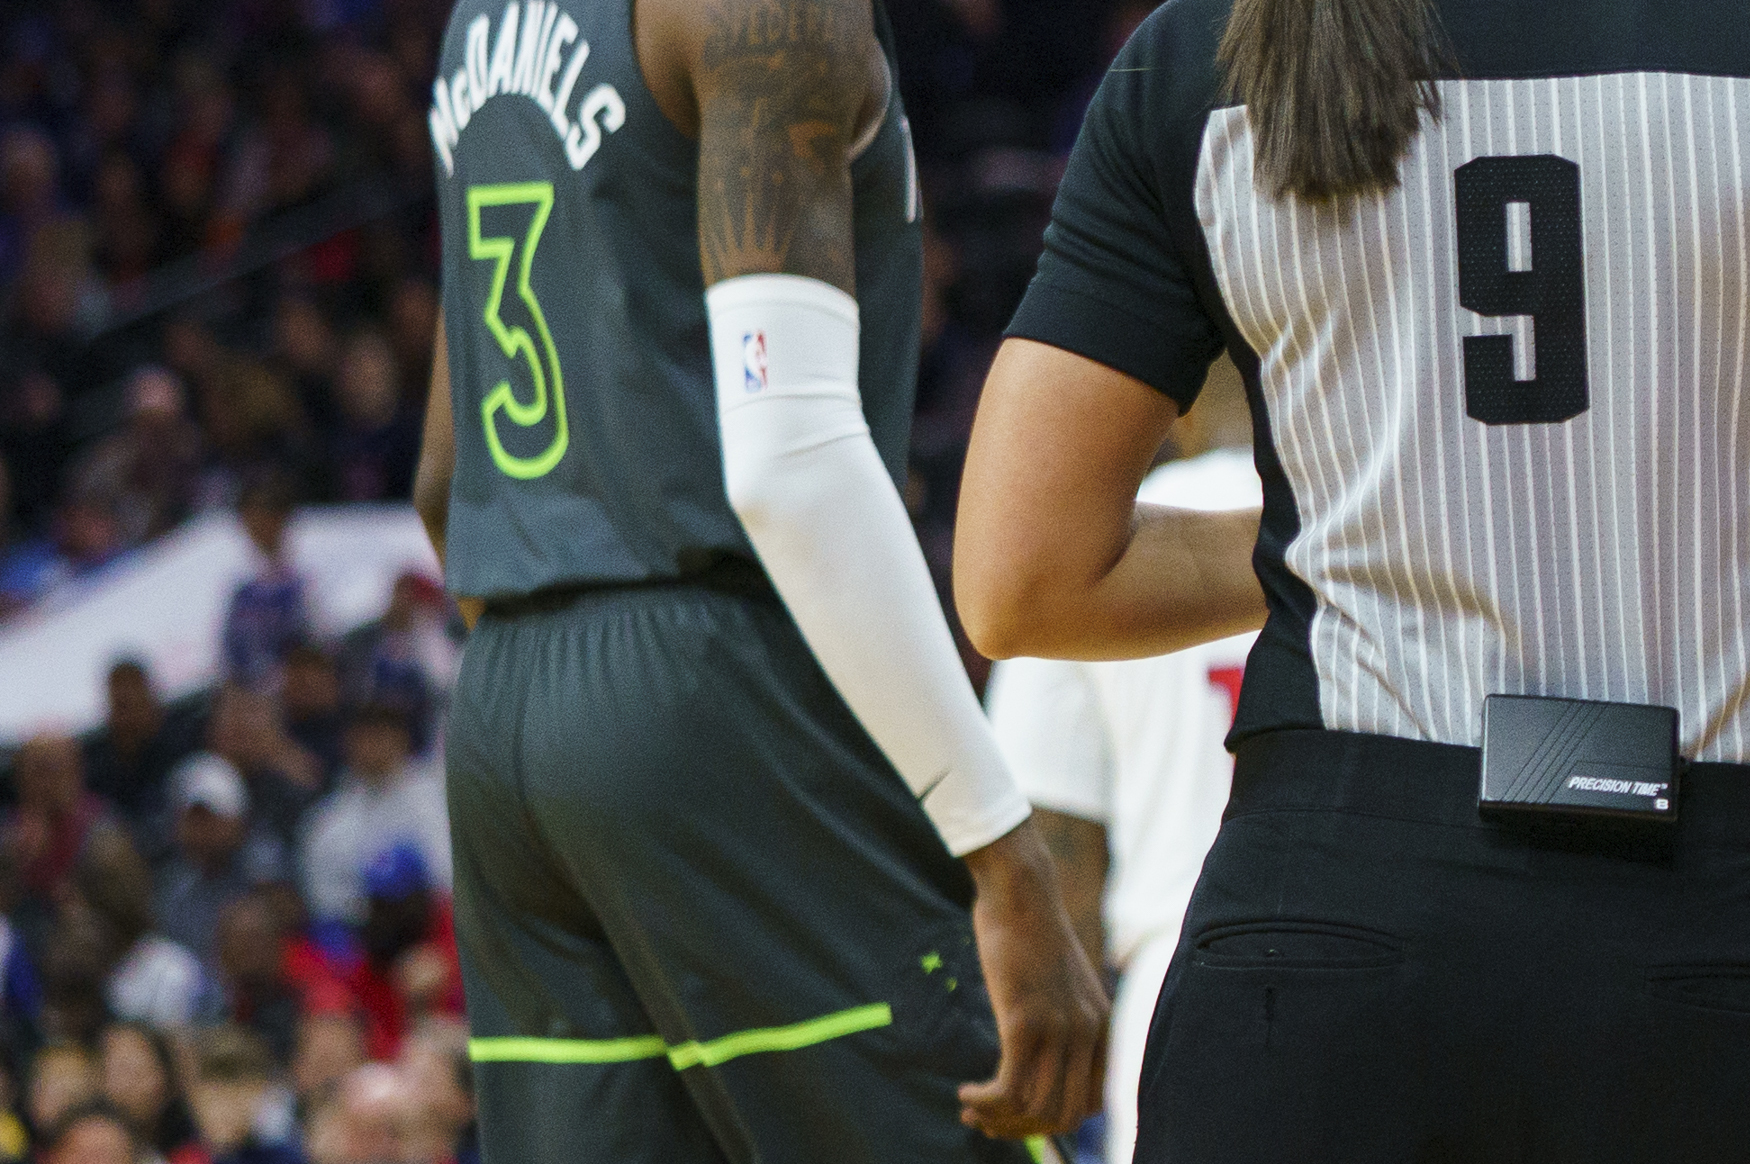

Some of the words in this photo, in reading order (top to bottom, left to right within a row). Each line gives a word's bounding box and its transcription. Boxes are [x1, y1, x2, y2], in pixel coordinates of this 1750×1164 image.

[465, 181, 569, 481] 3
[1454, 153, 1590, 426] 9
[1567, 776, 1633, 794] PRECISION
